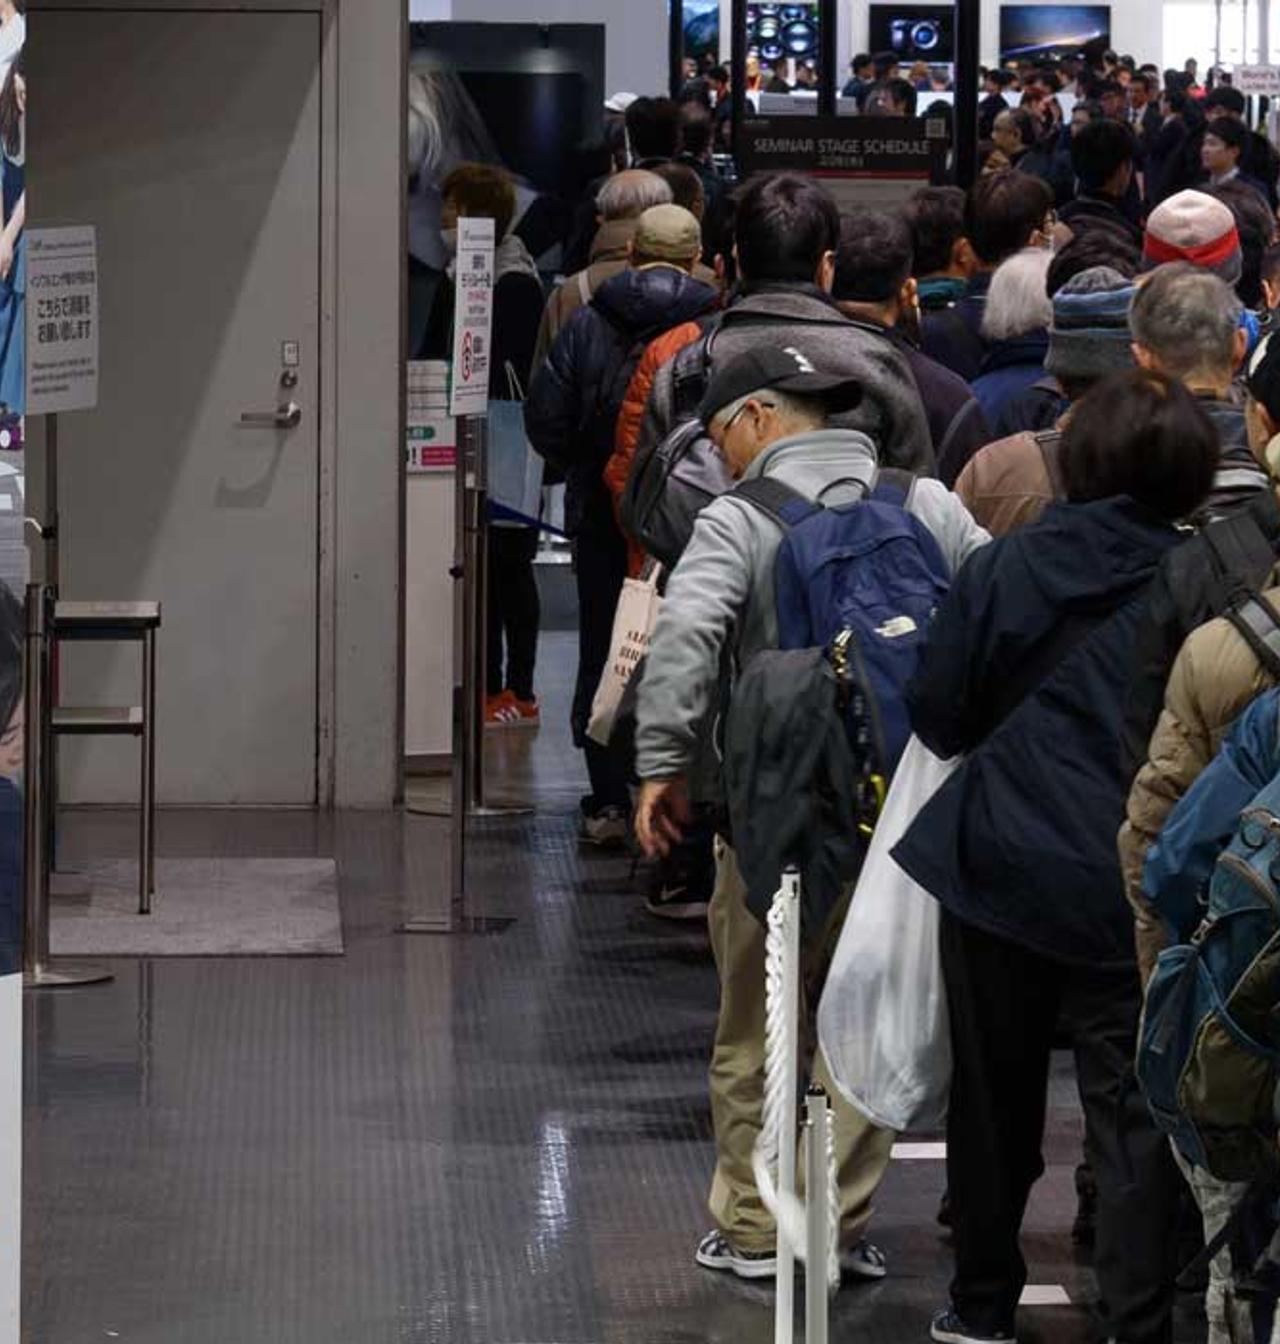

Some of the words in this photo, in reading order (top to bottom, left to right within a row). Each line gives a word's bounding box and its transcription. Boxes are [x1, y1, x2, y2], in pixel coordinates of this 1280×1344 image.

[753, 138, 814, 154] SEMINAR
[817, 139, 861, 154] STAGE
[863, 139, 931, 155] SCHEDULE
